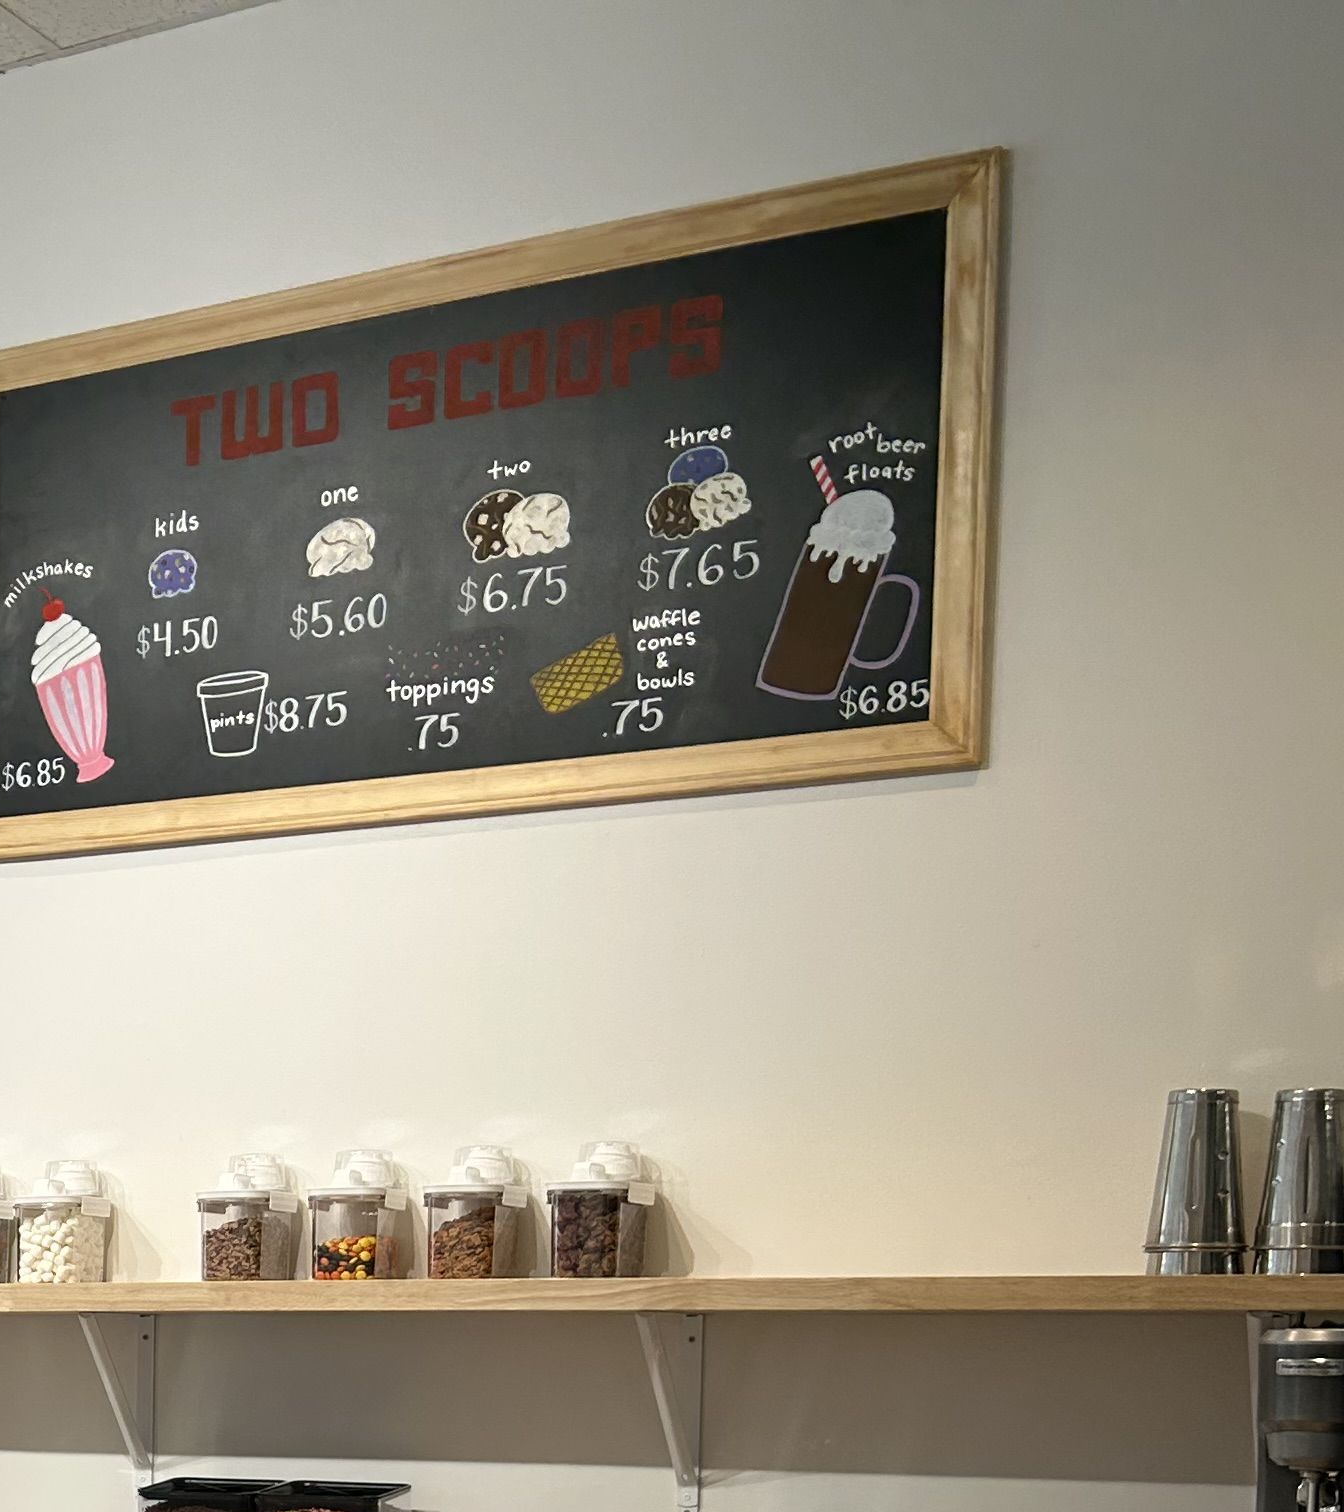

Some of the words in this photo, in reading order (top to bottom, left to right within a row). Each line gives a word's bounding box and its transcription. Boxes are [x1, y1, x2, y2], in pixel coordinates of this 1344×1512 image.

[170, 370, 340, 466] TWO
[387, 295, 723, 431] SCOOPS
[664, 424, 732, 448] three
[828, 421, 878, 453] root
[876, 433, 927, 454] beer
[487, 460, 530, 480] two
[844, 459, 917, 484] floats
[320, 485, 359, 507] one
[154, 509, 200, 538] kids
[637, 539, 760, 591] $7.65
[3, 558, 94, 609] milkshakes
[456, 565, 567, 616] $6.75
[289, 592, 387, 640] $5.60
[632, 608, 701, 632] waffle
[136, 615, 219, 659] $4.50
[636, 630, 696, 652] cones
[655, 651, 669, 669] &
[386, 675, 495, 707] toppings
[636, 668, 695, 691] bowls
[264, 690, 348, 734] $8.75
[838, 679, 930, 720] $6.85
[210, 711, 255, 733] pints
[407, 712, 461, 751] .75
[601, 697, 664, 738] .75
[1, 757, 66, 791] $6.85
